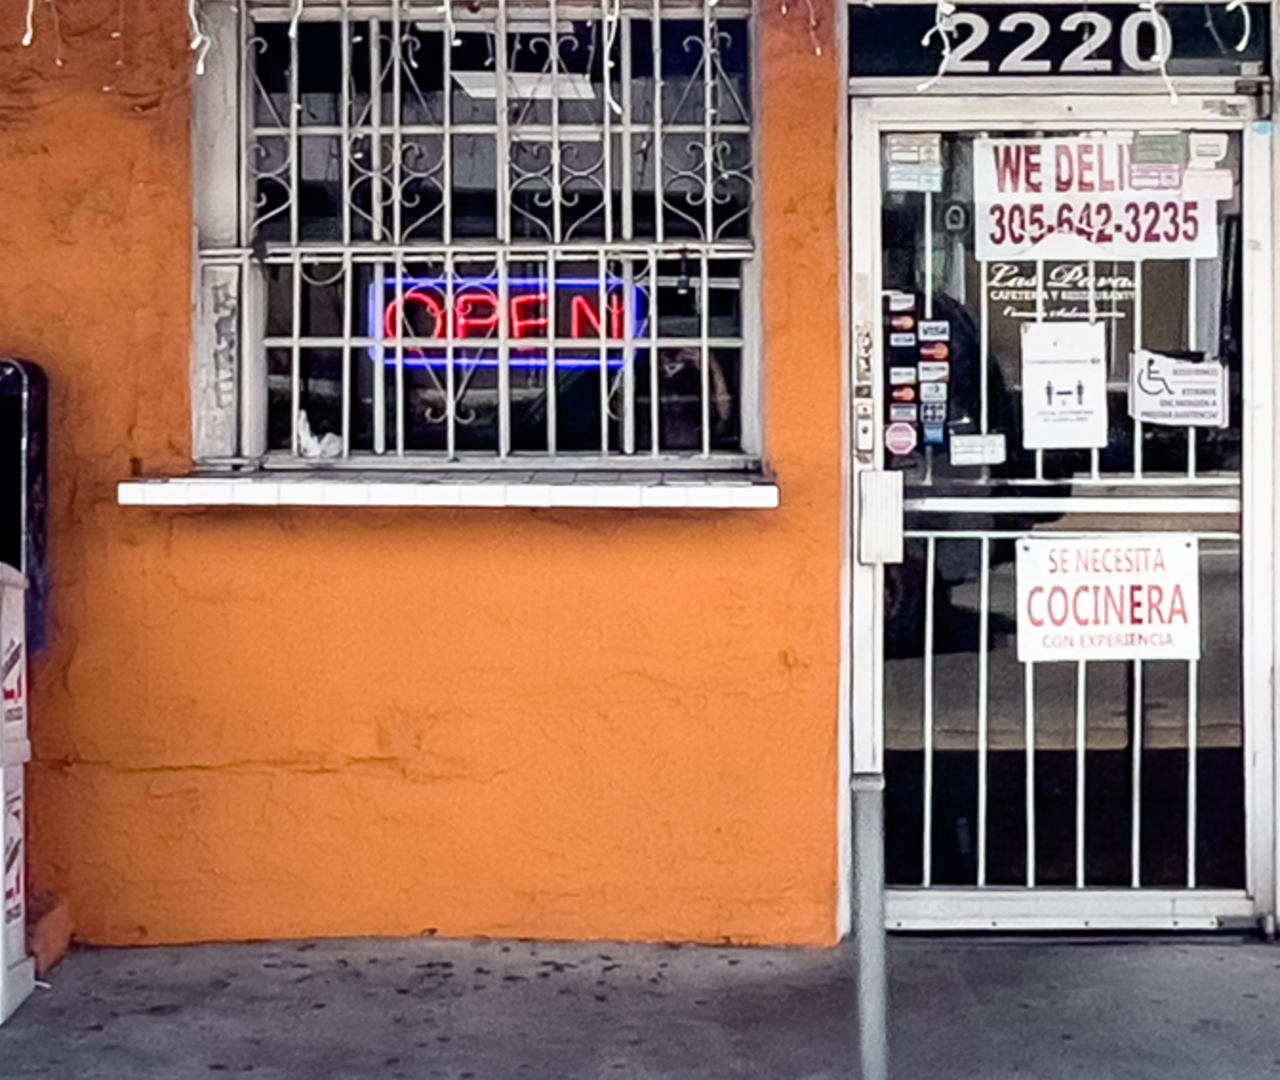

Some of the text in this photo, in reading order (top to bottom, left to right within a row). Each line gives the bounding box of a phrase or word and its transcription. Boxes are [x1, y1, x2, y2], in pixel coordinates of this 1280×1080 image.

[949, 11, 1172, 73] 2220
[993, 144, 1043, 193] WE
[1046, 264, 1136, 288] Pava
[384, 292, 626, 352] OPEN
[1048, 548, 1167, 574] SE NECESITA
[1026, 584, 1189, 627] COCINERA
[1041, 633, 1174, 649] CON EXPERIENCIA
